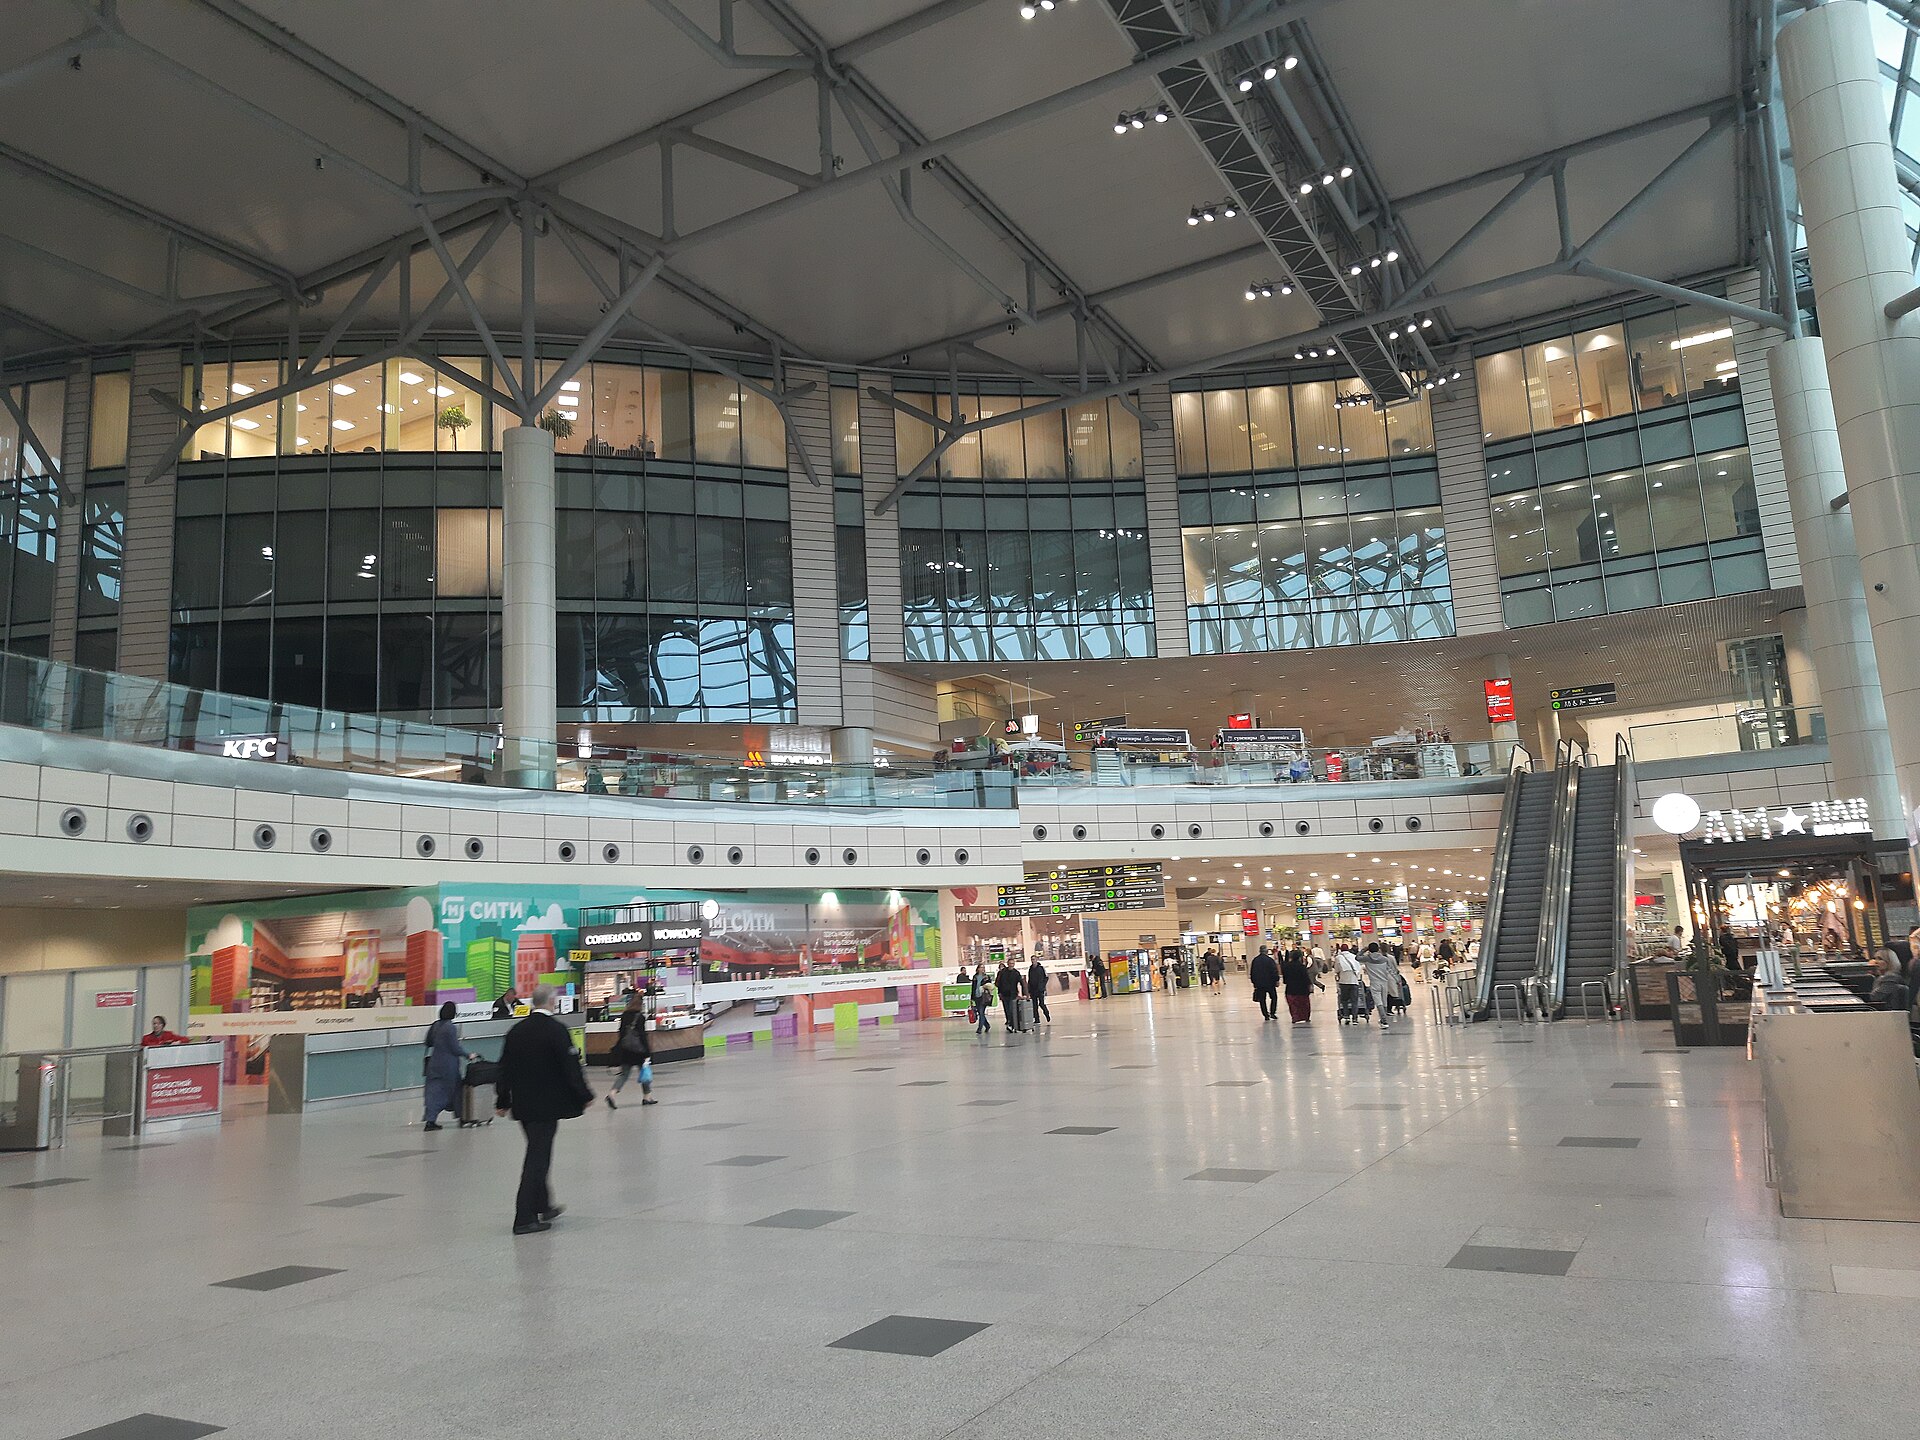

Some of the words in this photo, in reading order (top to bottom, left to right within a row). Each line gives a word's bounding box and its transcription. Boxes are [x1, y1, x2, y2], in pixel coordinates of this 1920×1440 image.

[223, 737, 277, 758] KFC
[1703, 806, 1773, 844] AM
[470, 901, 523, 919] СИТИ
[956, 912, 982, 922] МАГНИТ
[731, 911, 775, 932] СИТИ
[570, 951, 588, 960] TAXI
